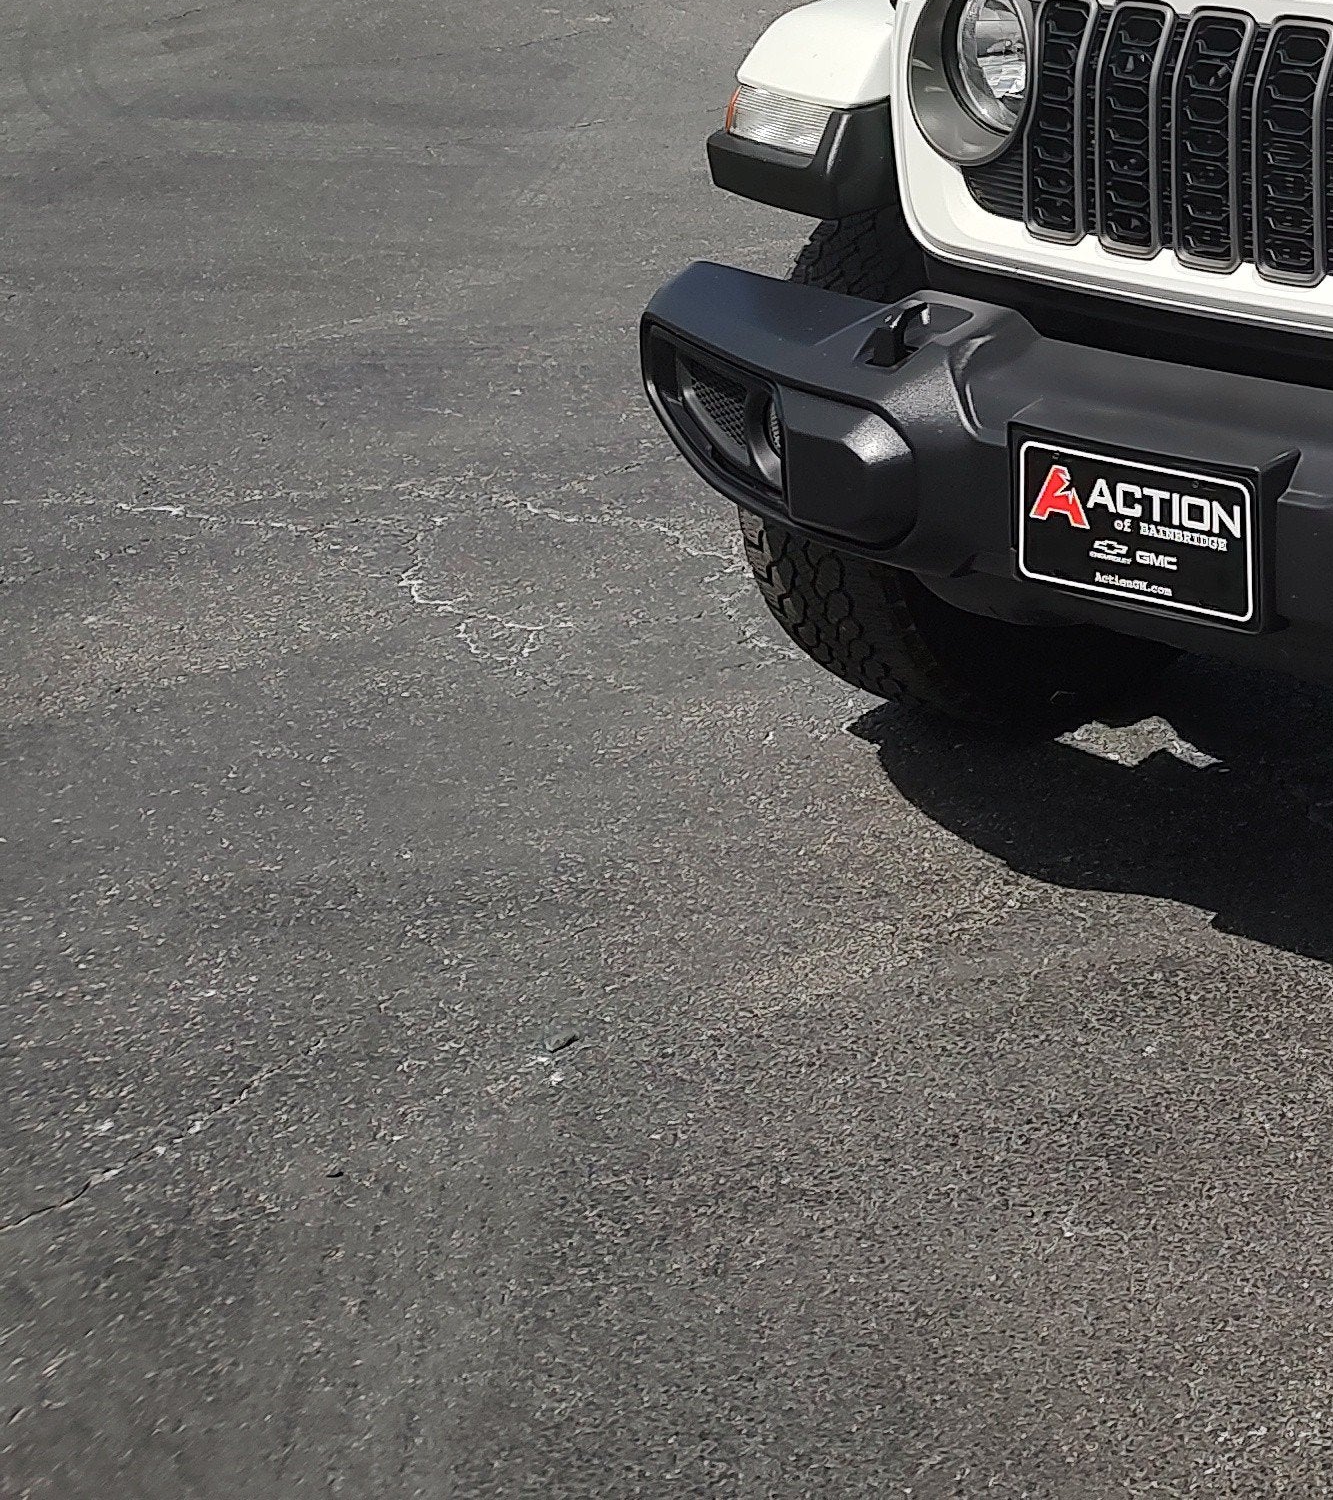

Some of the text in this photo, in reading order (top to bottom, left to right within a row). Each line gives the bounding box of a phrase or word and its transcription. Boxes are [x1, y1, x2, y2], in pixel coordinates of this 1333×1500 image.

[1086, 478, 1242, 539] ACTION
[1113, 518, 1229, 552] of BAINBRIDGE
[1135, 550, 1178, 571] GMC
